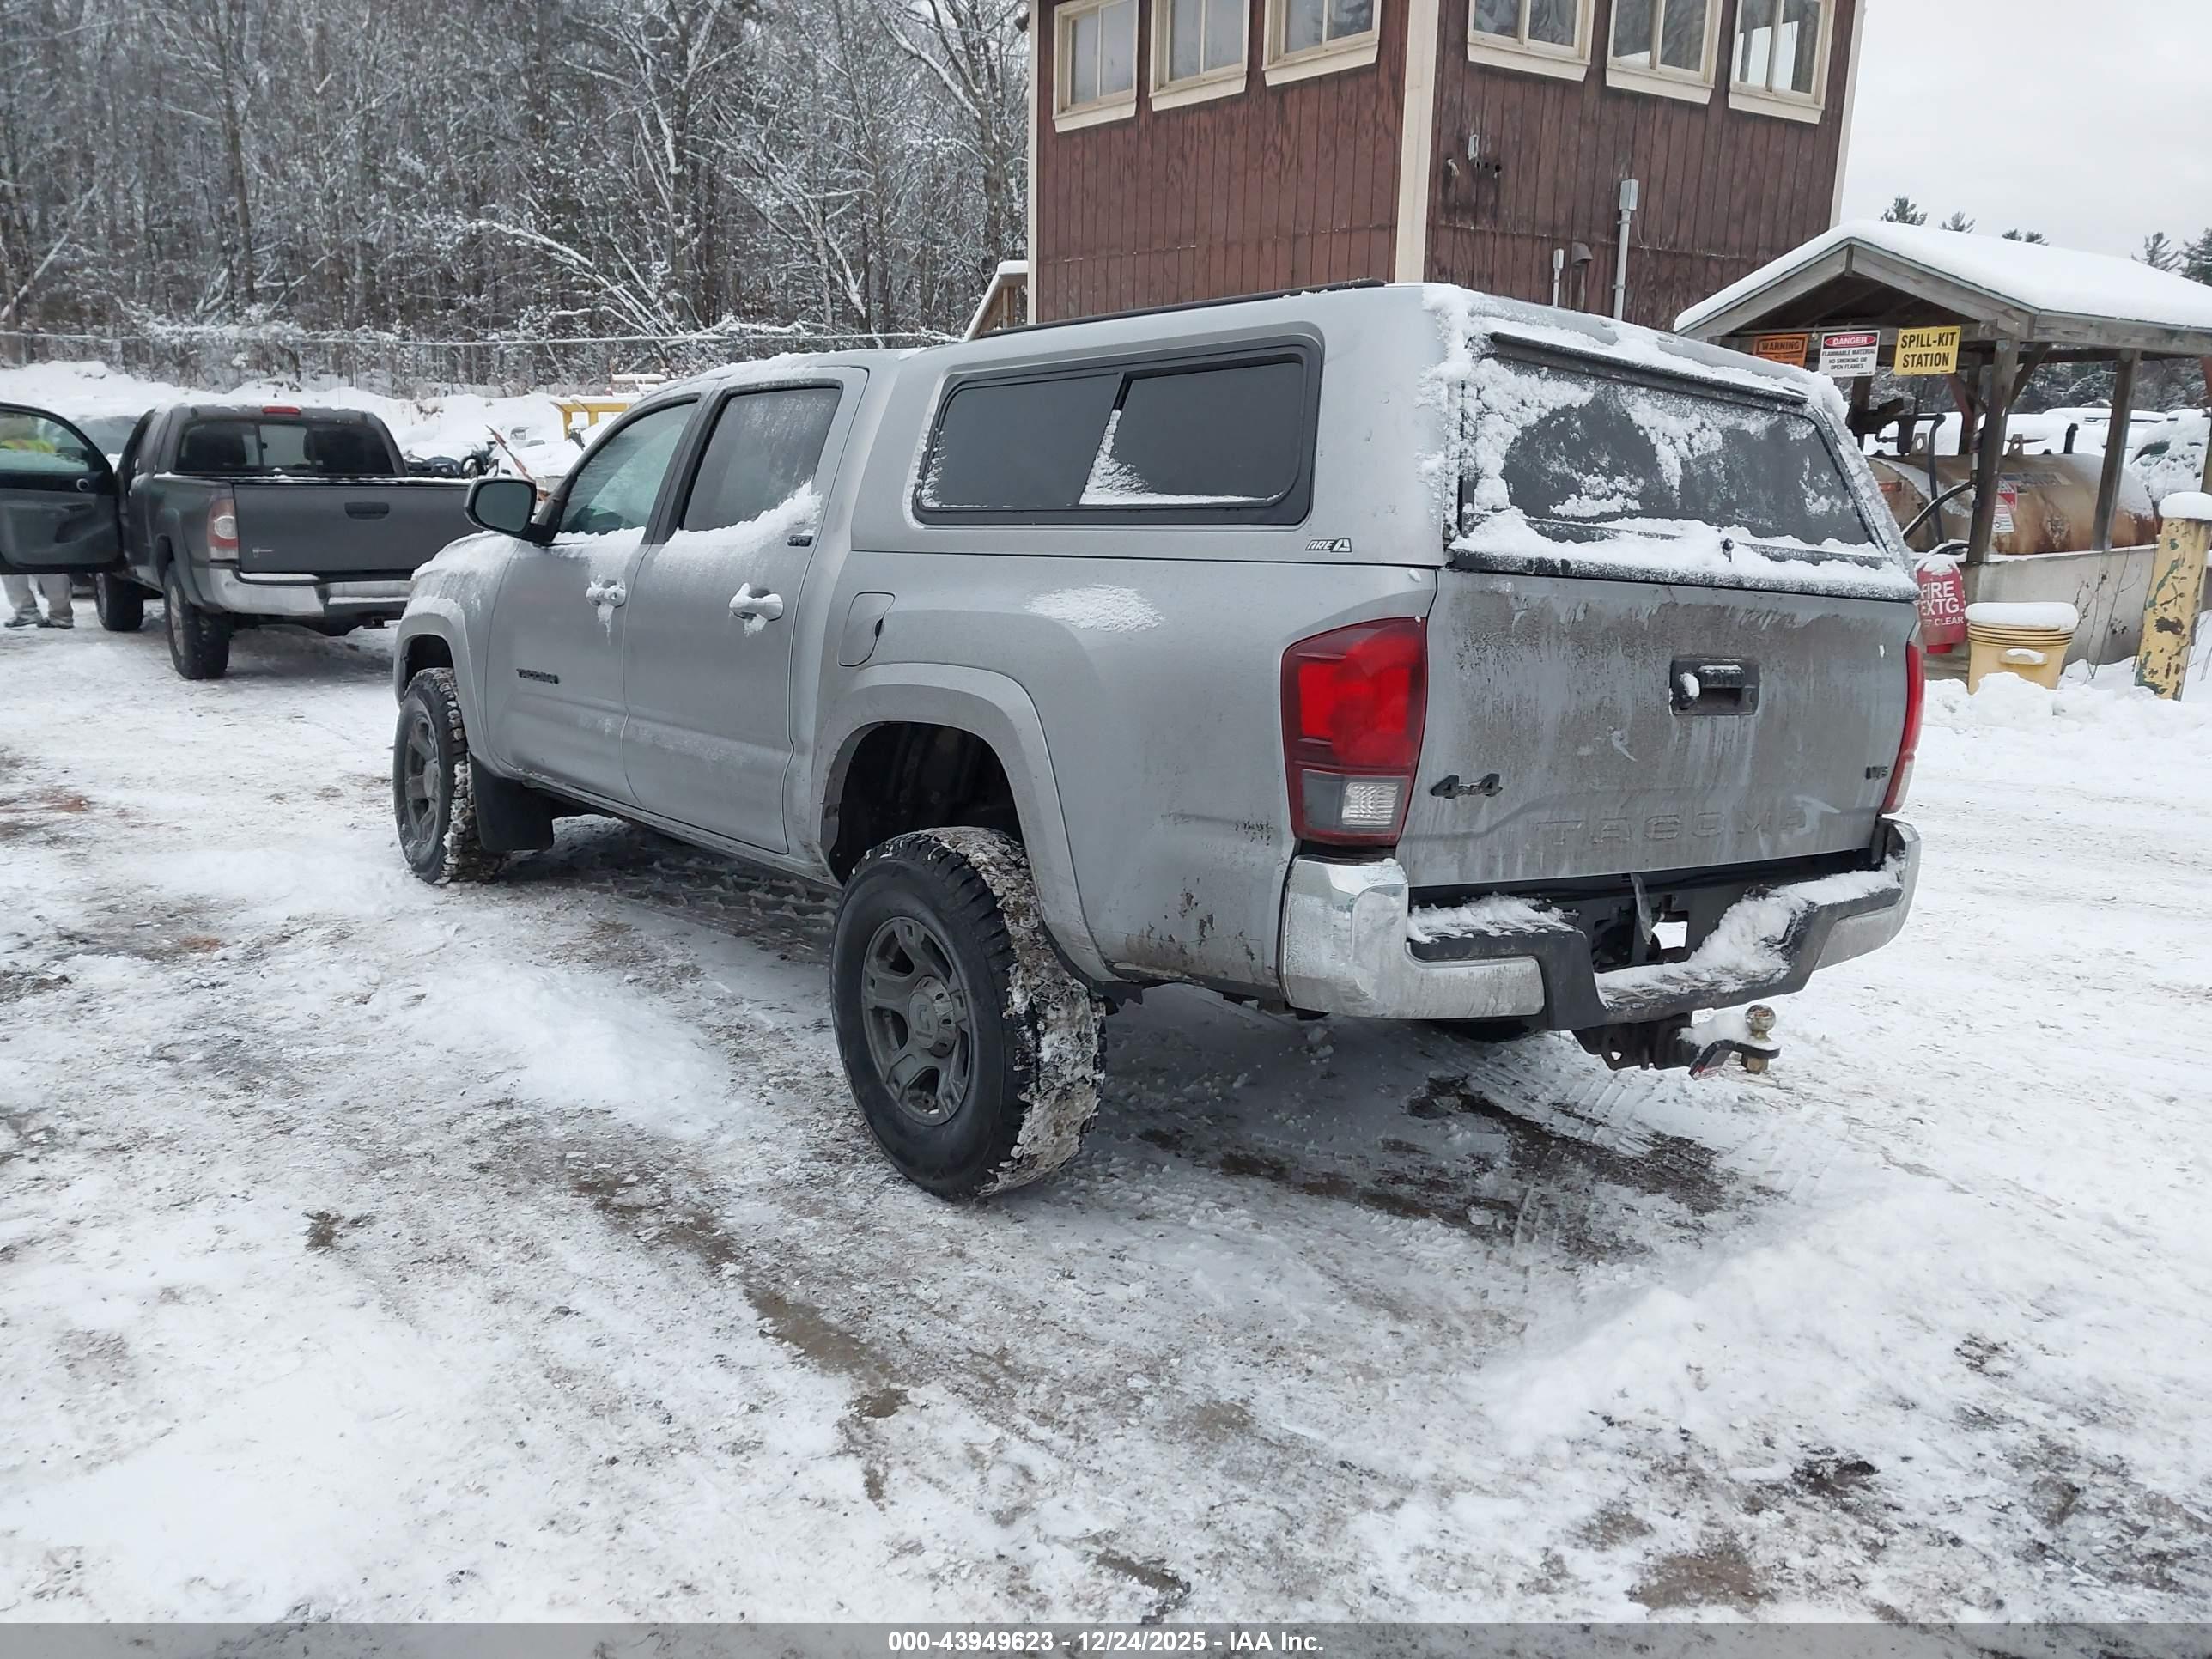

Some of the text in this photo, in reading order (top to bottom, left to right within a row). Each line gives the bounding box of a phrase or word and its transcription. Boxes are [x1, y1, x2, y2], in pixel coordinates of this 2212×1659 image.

[1761, 341, 1800, 350] WARNING
[1832, 336, 1868, 346] DANGER
[1900, 332, 1957, 349] SPILL-KIT
[1902, 352, 1949, 368] STATION
[1920, 580, 1955, 599] FIRE
[1934, 616, 1965, 626] CLEAR
